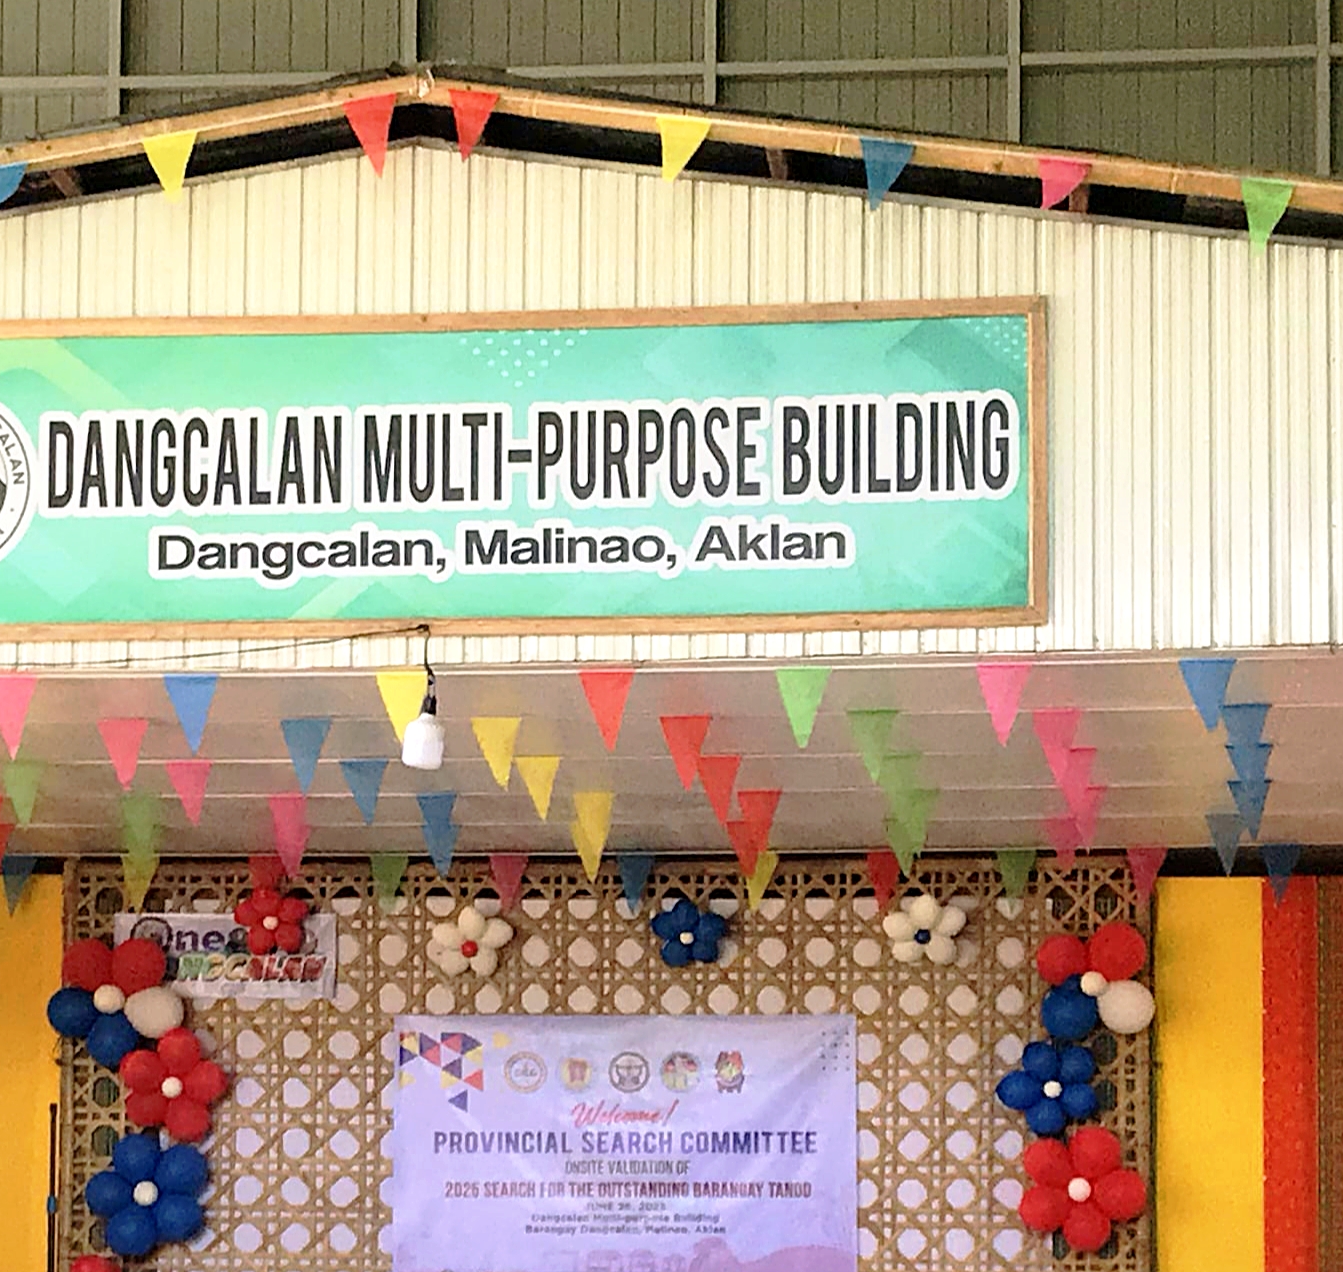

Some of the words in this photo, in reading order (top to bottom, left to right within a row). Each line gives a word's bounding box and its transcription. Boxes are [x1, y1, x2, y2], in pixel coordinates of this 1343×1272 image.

[48, 415, 342, 508] DANGCALAN
[365, 406, 761, 503] MULTI-PURPOSE
[782, 399, 1010, 496] BUILDING
[158, 530, 447, 578] Dangcalan,
[465, 527, 677, 570] Malinao,
[695, 522, 846, 562] Aklan
[434, 1131, 573, 1154] PROVINCIAL
[582, 1131, 672, 1154] SEARCH
[680, 1131, 817, 1154] COMMITTEE
[565, 1160, 604, 1174] ONSITE
[608, 1160, 672, 1174] VALIDATION
[676, 1160, 691, 1174] OF
[483, 1181, 535, 1198] SEARCH
[540, 1181, 565, 1198] FOR
[568, 1181, 594, 1198] THE
[598, 1181, 689, 1198] OUTSTANDING
[693, 1181, 764, 1198] BARANGAY
[768, 1181, 812, 1198] TANOD
